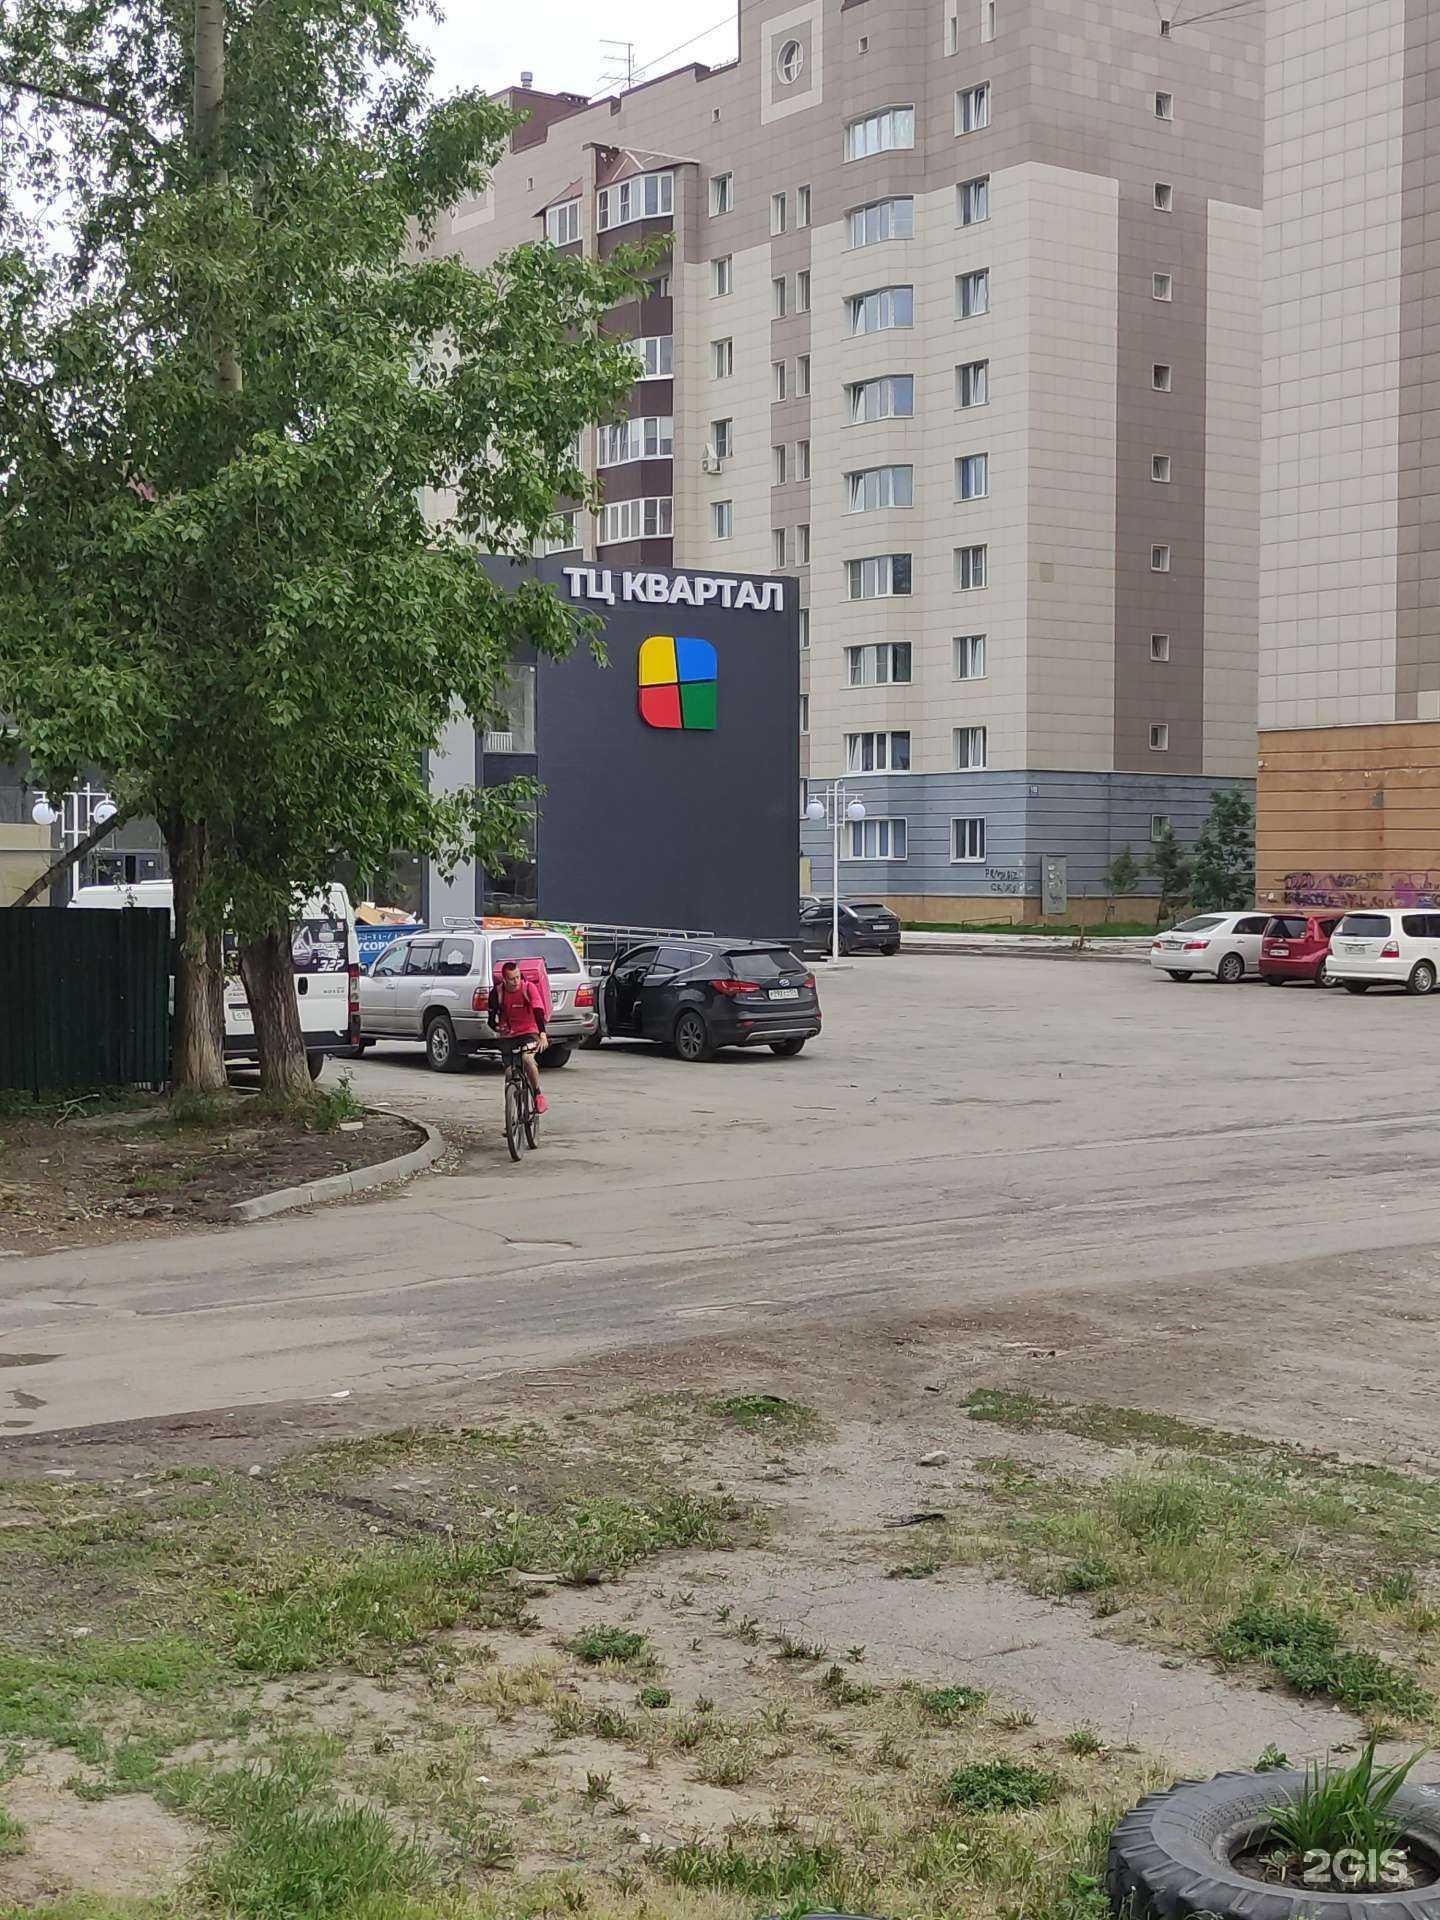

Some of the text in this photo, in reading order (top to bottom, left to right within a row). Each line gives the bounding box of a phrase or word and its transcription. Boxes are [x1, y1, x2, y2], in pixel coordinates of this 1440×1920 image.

[562, 566, 784, 612] ТЦ КВАРТАЛ
[317, 959, 345, 972] 327
